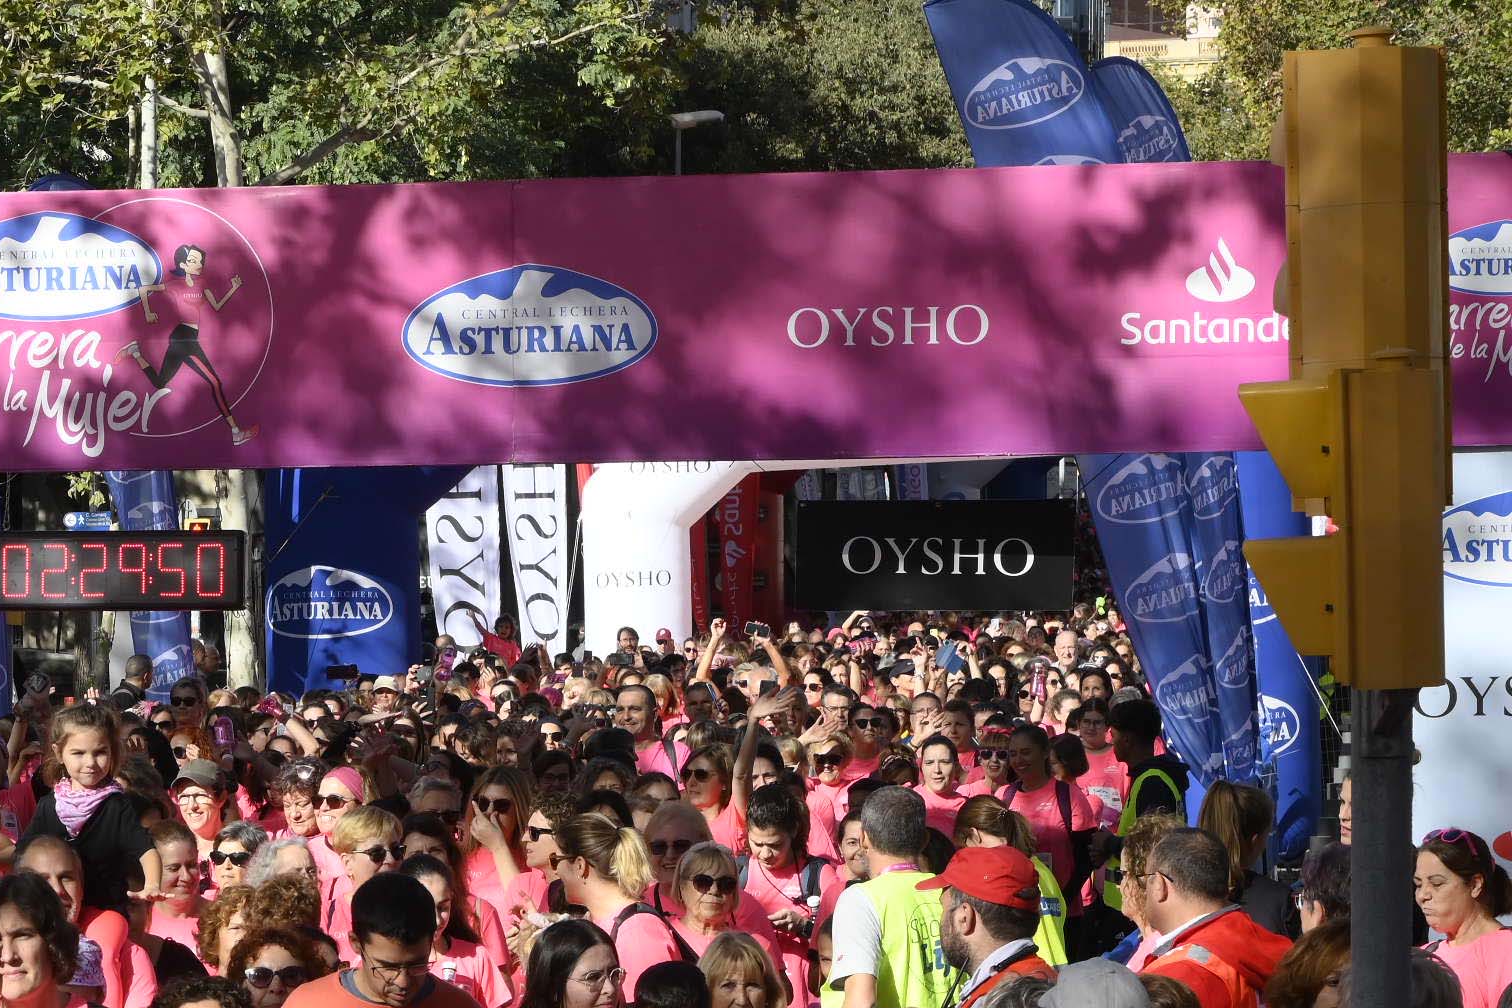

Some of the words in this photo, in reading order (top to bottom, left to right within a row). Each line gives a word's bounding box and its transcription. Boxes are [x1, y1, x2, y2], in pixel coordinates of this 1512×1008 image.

[462, 306, 539, 319] CENTRAL
[548, 305, 629, 318] LECHERA
[787, 304, 989, 348] OYSHO
[423, 312, 637, 355] ASTURIANA
[3, 373, 29, 412] la
[23, 363, 171, 457] Mujer
[3, 543, 223, 597] 02:29:50
[842, 536, 1035, 577] OYSHO
[596, 569, 671, 588] OYSHO
[272, 596, 384, 623] ASTURIANA
